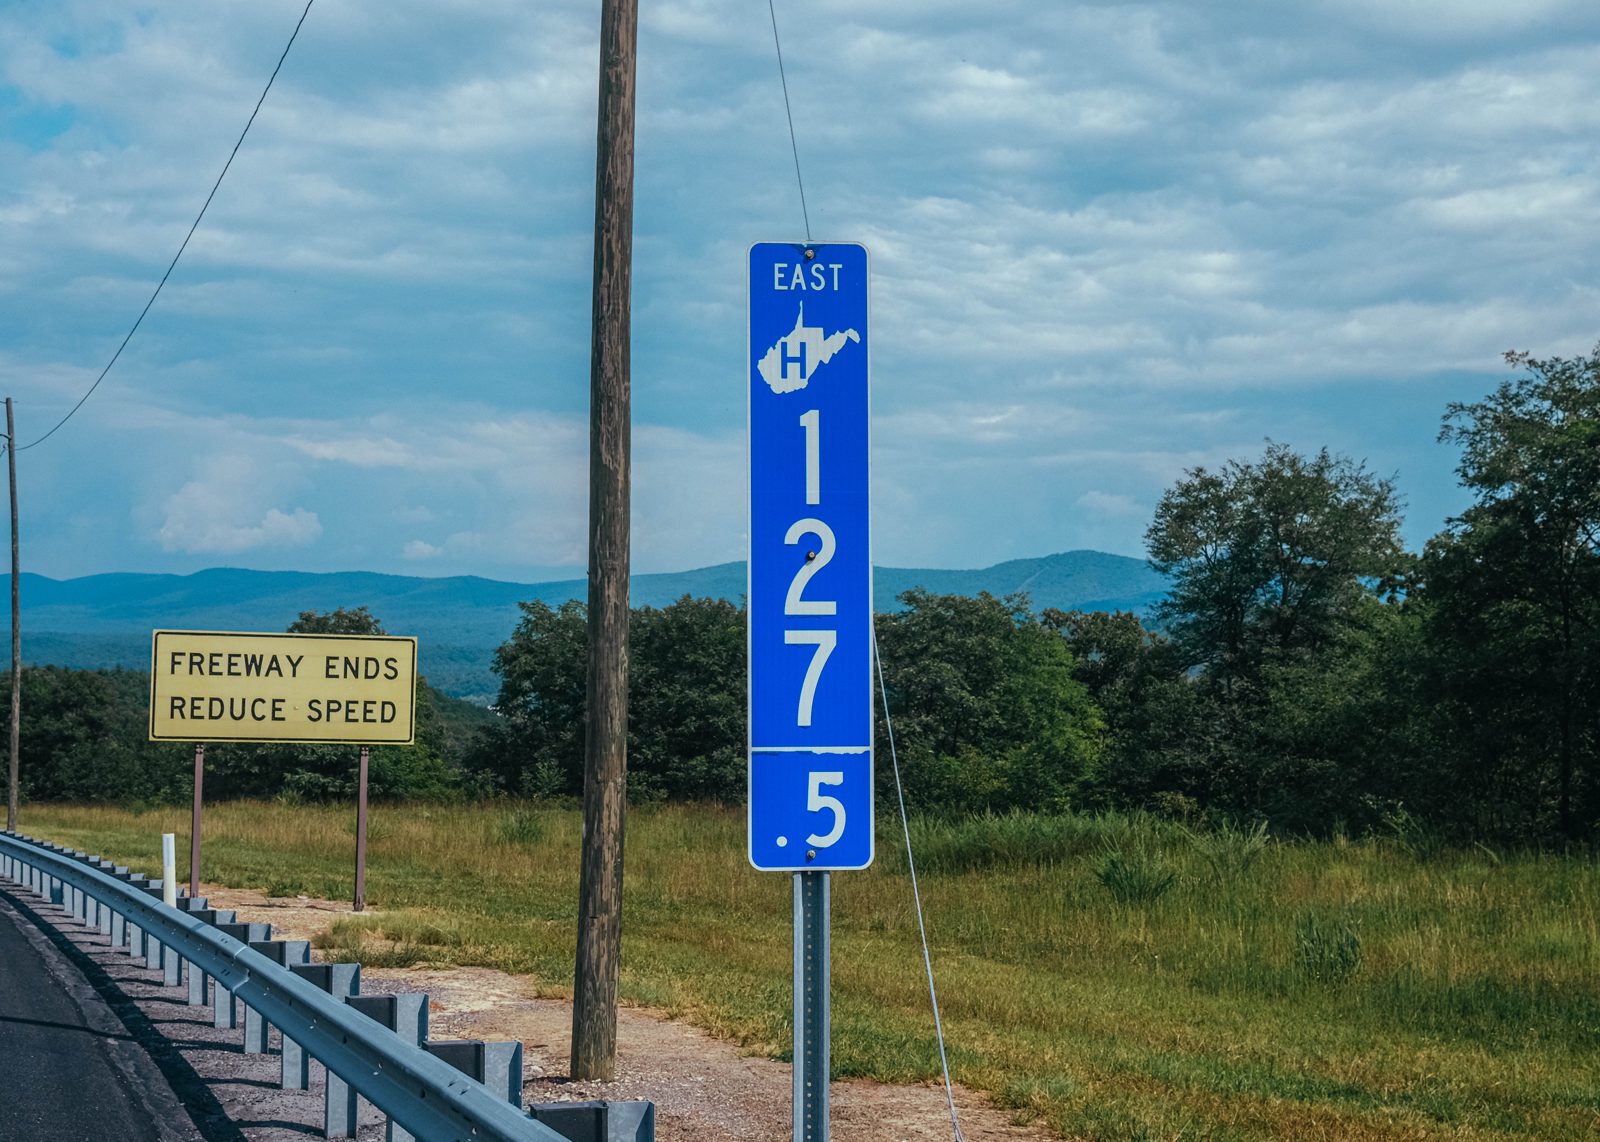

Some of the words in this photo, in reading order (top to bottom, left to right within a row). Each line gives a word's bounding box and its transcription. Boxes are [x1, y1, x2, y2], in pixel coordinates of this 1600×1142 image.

[774, 263, 843, 291] EAST
[780, 341, 807, 379] H
[170, 652, 304, 678] FREEWAY
[325, 655, 399, 681] ENDS
[169, 696, 286, 721] REDUCE
[307, 699, 397, 724] SPEED
